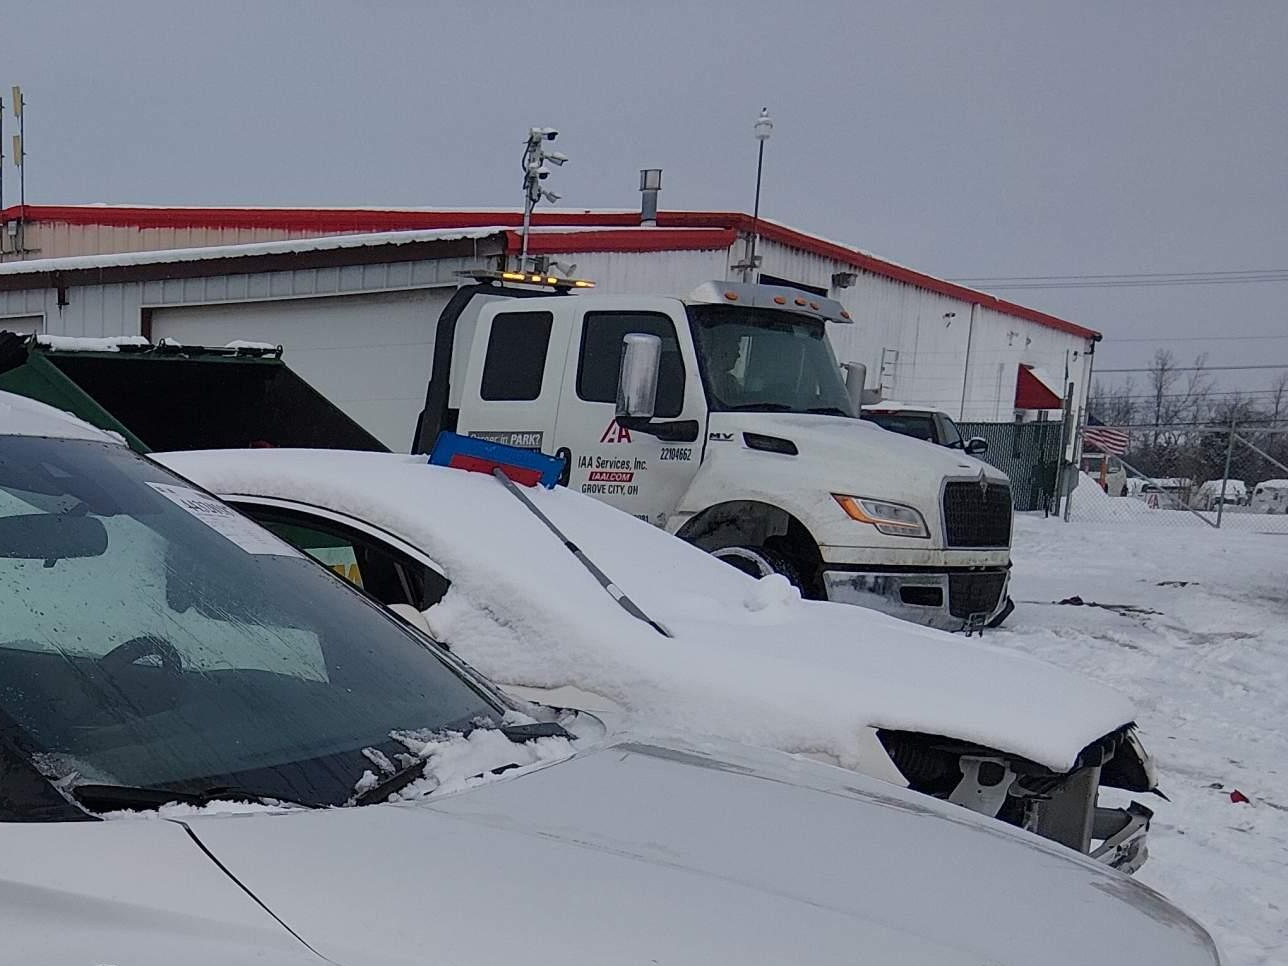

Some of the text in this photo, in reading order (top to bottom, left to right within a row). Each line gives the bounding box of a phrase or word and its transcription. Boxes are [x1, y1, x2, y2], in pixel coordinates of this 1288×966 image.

[511, 434, 541, 446] PARK?
[578, 456, 648, 471] IAA Services, Inc.
[581, 483, 639, 496] GROVE CITY, OH
